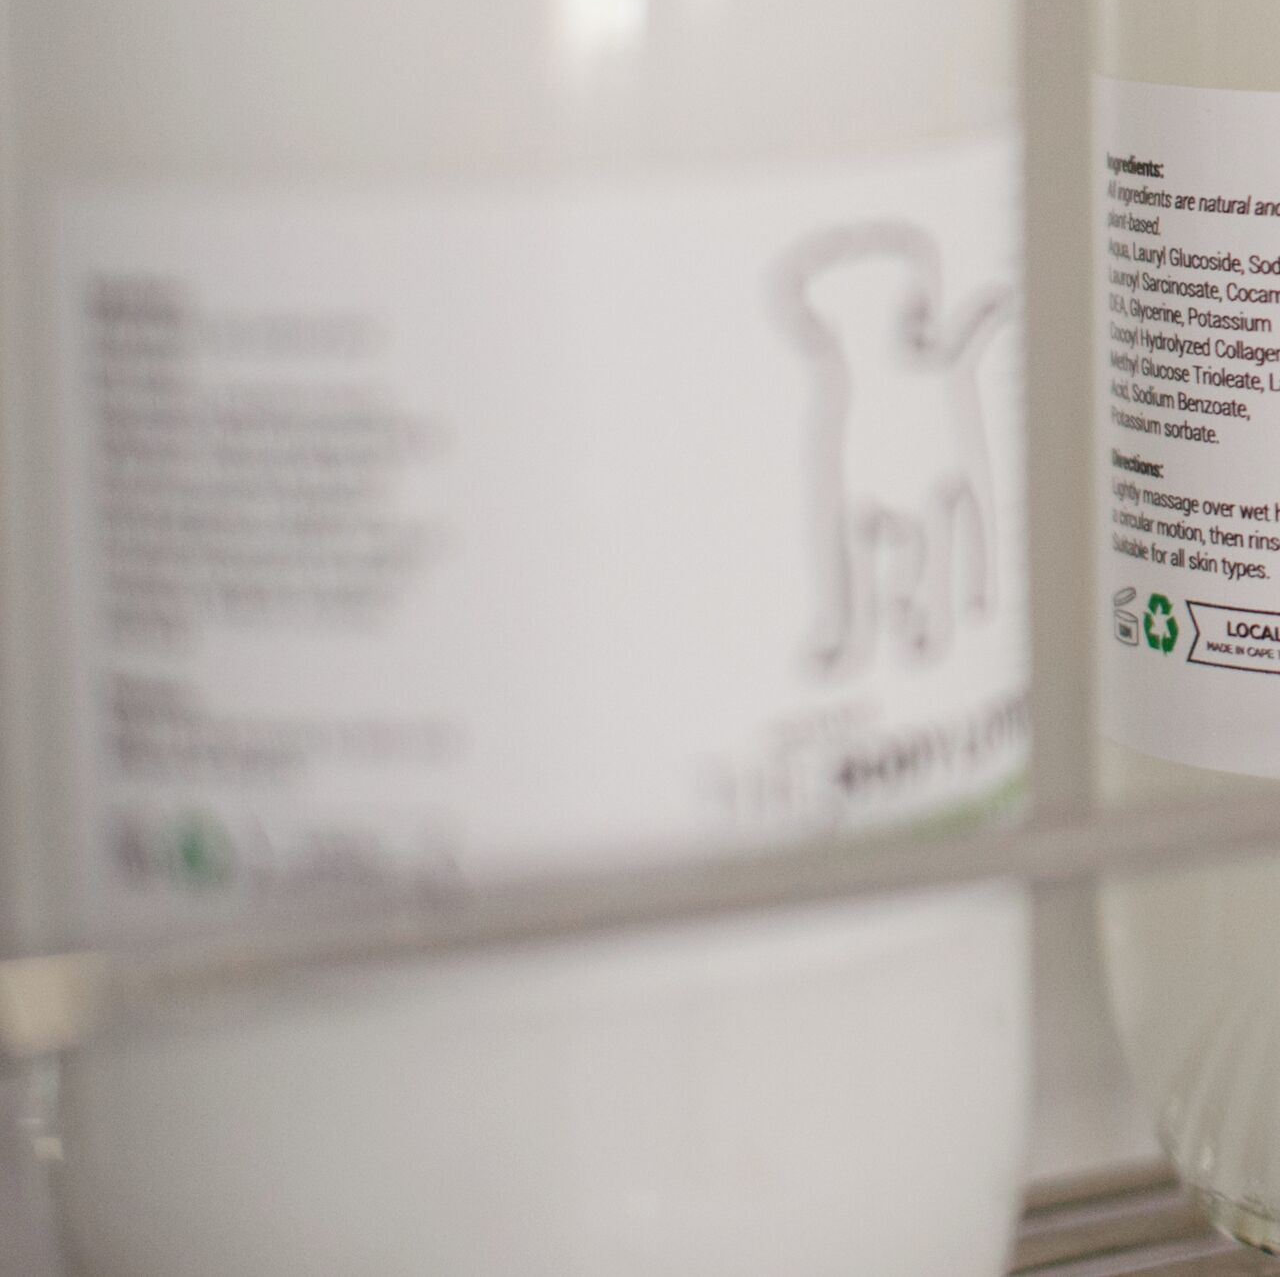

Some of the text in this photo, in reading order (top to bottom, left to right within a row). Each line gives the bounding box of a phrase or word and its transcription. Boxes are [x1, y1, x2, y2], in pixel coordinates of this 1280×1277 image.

[1107, 152, 1164, 178] Ingredients:
[1117, 186, 1172, 209] ingredients
[1175, 194, 1195, 210] are
[1199, 195, 1252, 215] natural
[1132, 242, 1166, 268] Lauryl
[1169, 248, 1245, 275] Glucoside,
[1142, 273, 1223, 302] Sarcinosate,
[1130, 297, 1185, 327] Glycerine,
[1188, 308, 1272, 332] Potassium
[1140, 329, 1211, 357] Hydrolyzed
[1141, 357, 1190, 383] Glucose
[1193, 365, 1265, 393] Trioleate,
[1132, 383, 1175, 409] Sodium
[1178, 392, 1251, 420] Benzoate,
[1111, 406, 1220, 444] Potassium sorbate.
[1111, 448, 1164, 478] Directions:
[1143, 488, 1199, 514] massage
[1203, 500, 1236, 518] over
[1240, 503, 1270, 522] wet
[1119, 507, 1153, 534] circular
[1157, 518, 1206, 544] motion,
[1210, 527, 1244, 548] then
[1112, 531, 1270, 580] Suitable for all skin types.
[1206, 641, 1233, 655] MADE
[1235, 645, 1245, 656] IN
[1247, 646, 1275, 660] CAPE
